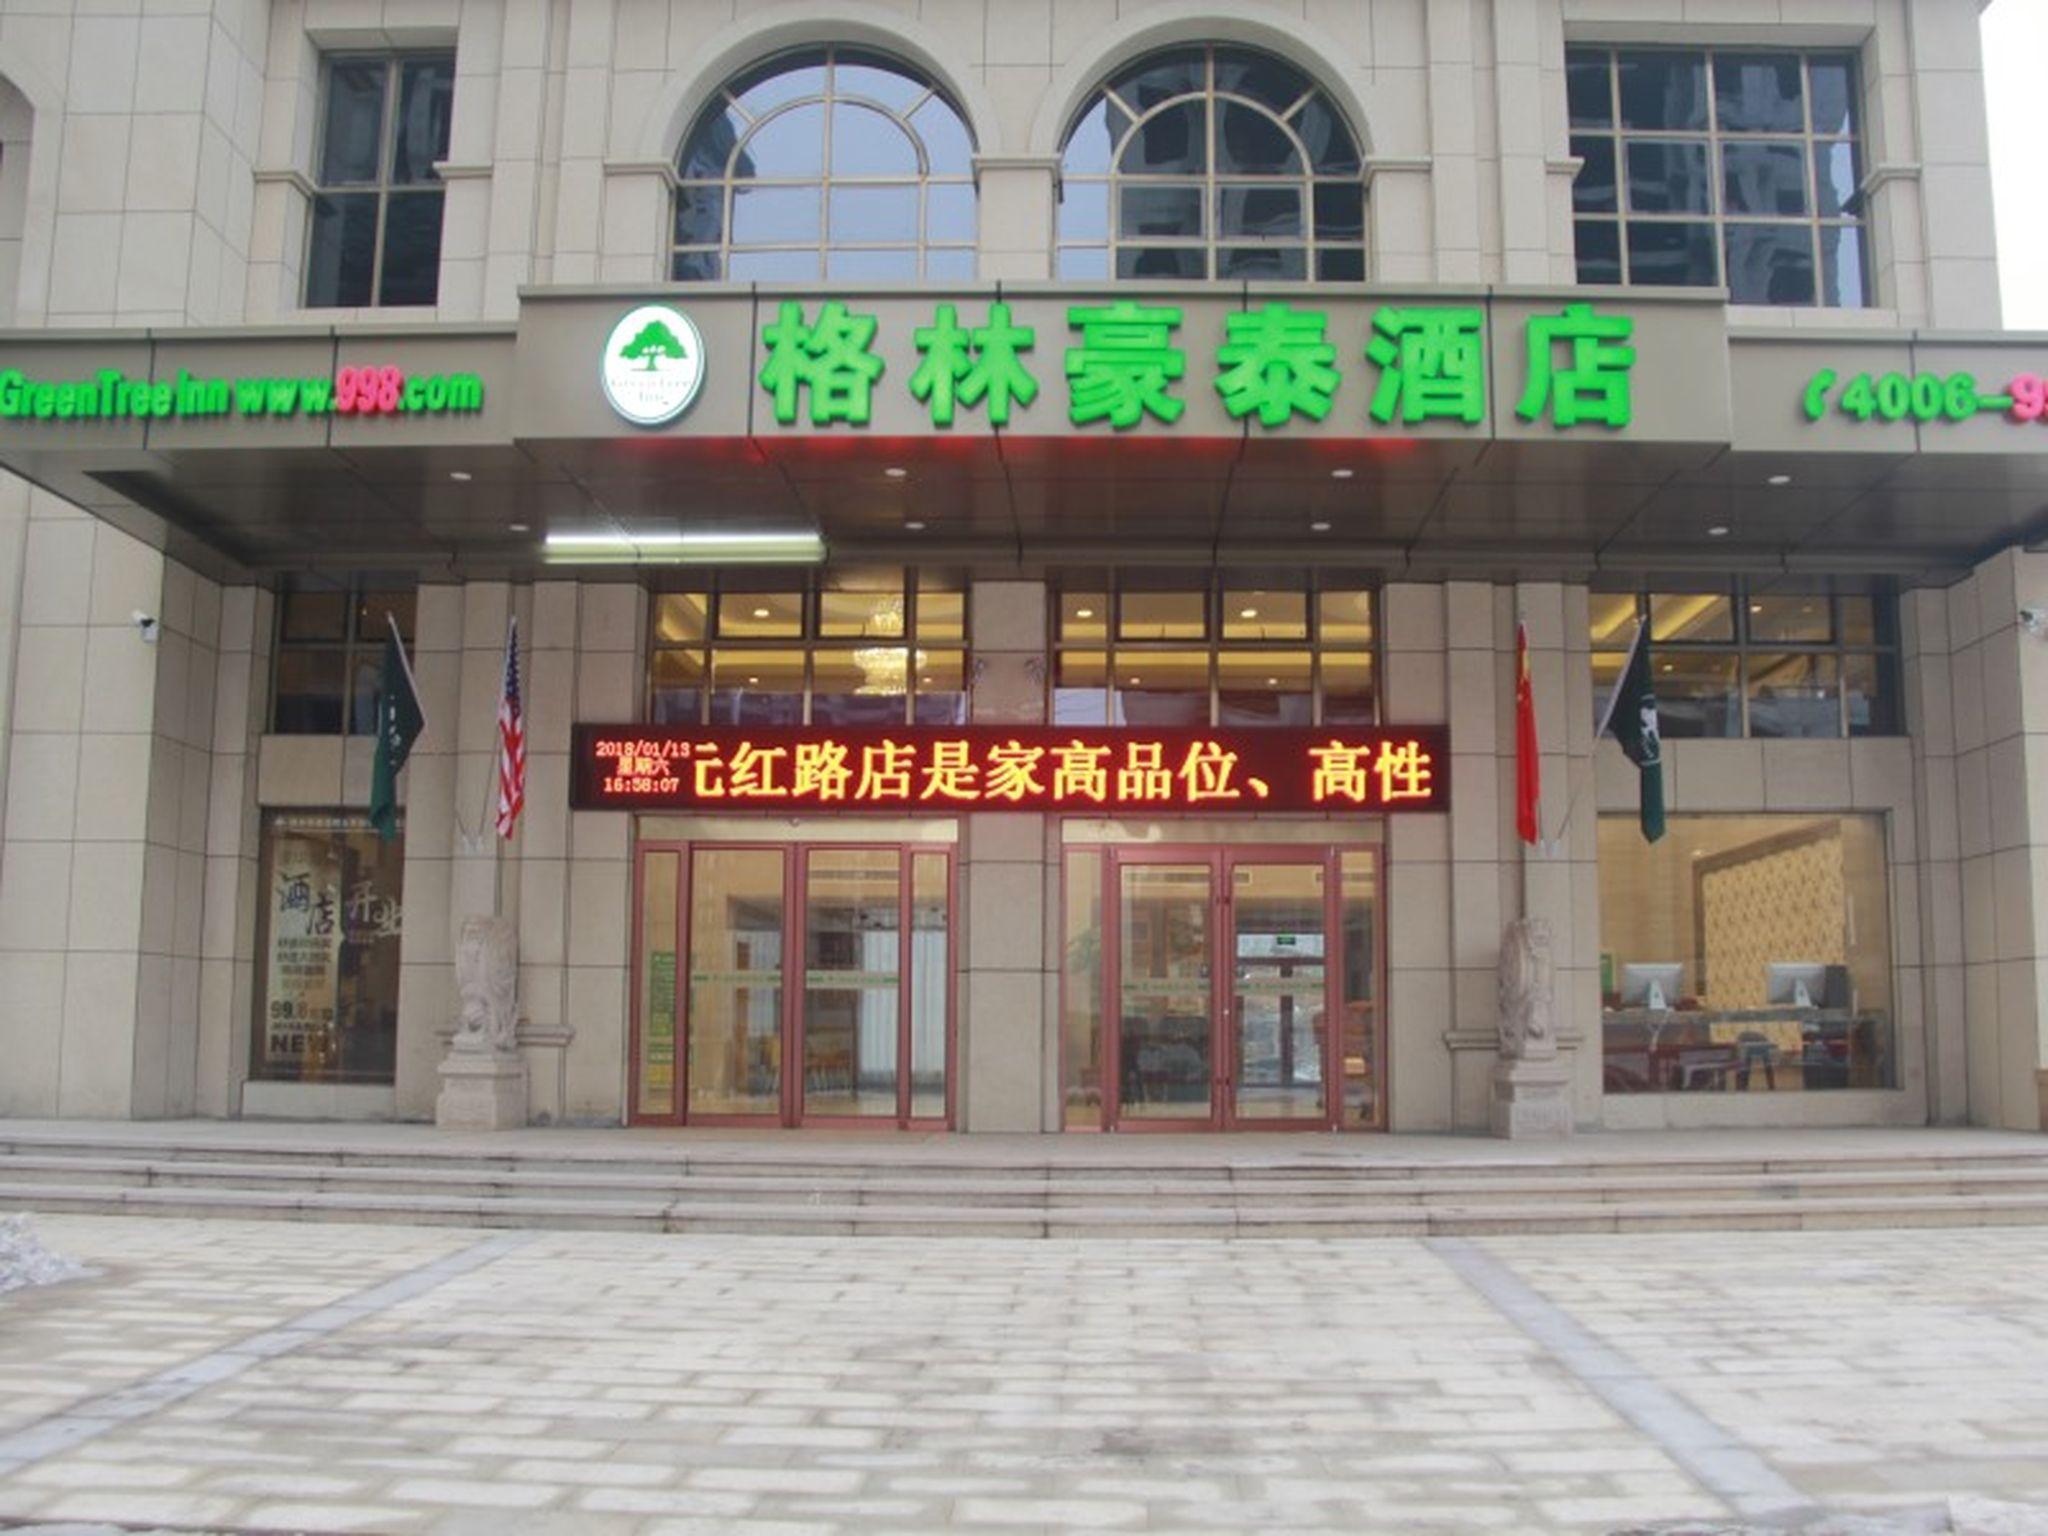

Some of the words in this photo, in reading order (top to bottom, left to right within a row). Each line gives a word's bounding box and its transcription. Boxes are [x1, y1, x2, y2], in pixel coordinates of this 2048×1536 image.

[758, 300, 1639, 428] 格林豪泰酒店
[234, 366, 482, 415] www.998.com
[596, 739, 690, 758] 2018/01/13
